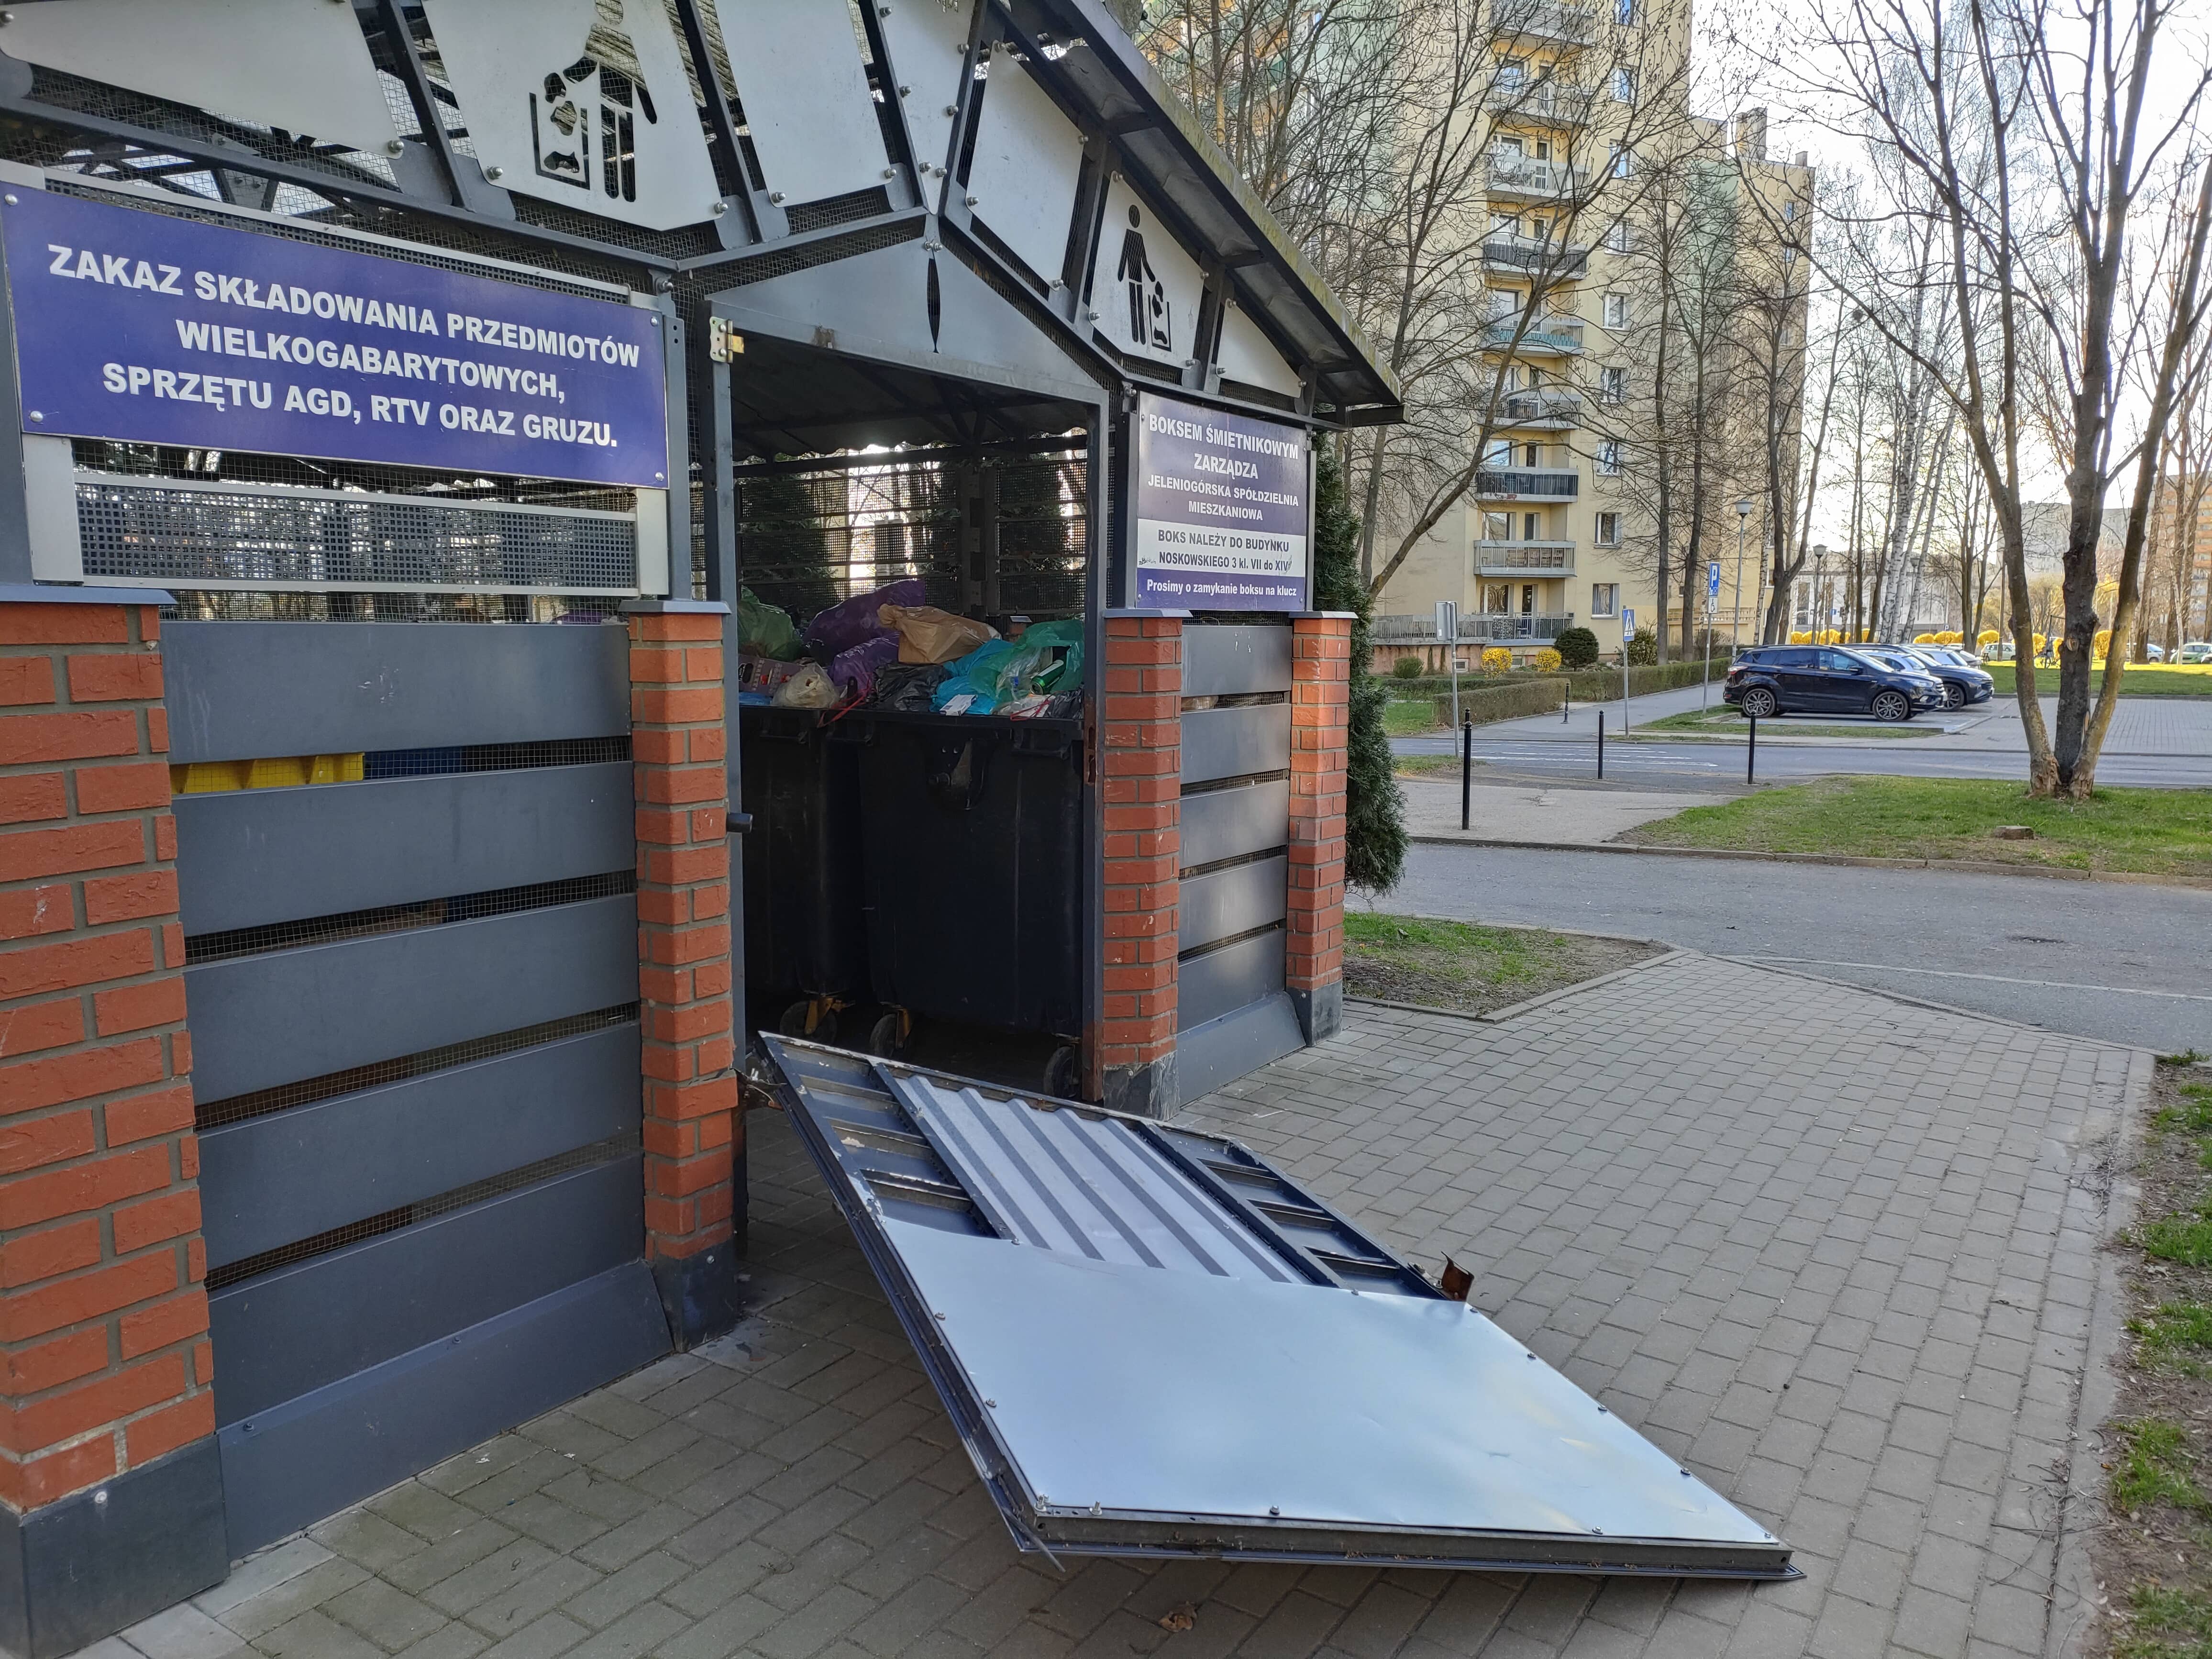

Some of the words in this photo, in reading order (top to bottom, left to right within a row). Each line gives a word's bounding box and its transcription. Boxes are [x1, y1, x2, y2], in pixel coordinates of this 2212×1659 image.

[48, 244, 183, 296] ZAKAZ
[195, 271, 439, 335] SKŁADOWANIA
[447, 313, 640, 368] PRZEDMIOTÓW
[175, 319, 565, 404] WIELKOGABARYTOWYCH,
[103, 363, 272, 411] SPRZĘTU
[284, 386, 360, 425] AGD,
[371, 395, 430, 426] RTV
[439, 403, 515, 435] ORAZ
[523, 414, 617, 447] GRUZU.
[1150, 414, 1202, 441] BOKSEM
[1206, 424, 1298, 459] ŚMIETNIKOWYM
[1194, 453, 1258, 479] ZARZĄDZA
[1148, 474, 1231, 497] JELENIOGÓRSKA
[1234, 487, 1299, 506] SPÓŁDZIELNIA
[1189, 501, 1263, 520] MIESZKANIOWA
[1158, 530, 1186, 543] BOKS
[1189, 532, 1227, 547] NALEŻY
[1230, 537, 1242, 548] DO
[1246, 538, 1289, 552] BUDYNKU
[1160, 552, 1229, 567] NOSKOWSKIEGO
[1232, 557, 1236, 568] 3
[1239, 558, 1248, 569] kl.
[1251, 559, 1261, 569] VII
[1264, 560, 1272, 570] do
[1275, 560, 1288, 571] XIV
[1147, 579, 1183, 595] Prosimy
[1186, 584, 1191, 592] o
[1194, 583, 1238, 596] zamykanie
[1240, 584, 1263, 595] boksu
[1266, 587, 1275, 595] na
[1277, 585, 1297, 596] klucz
[1711, 565, 1717, 586] P
